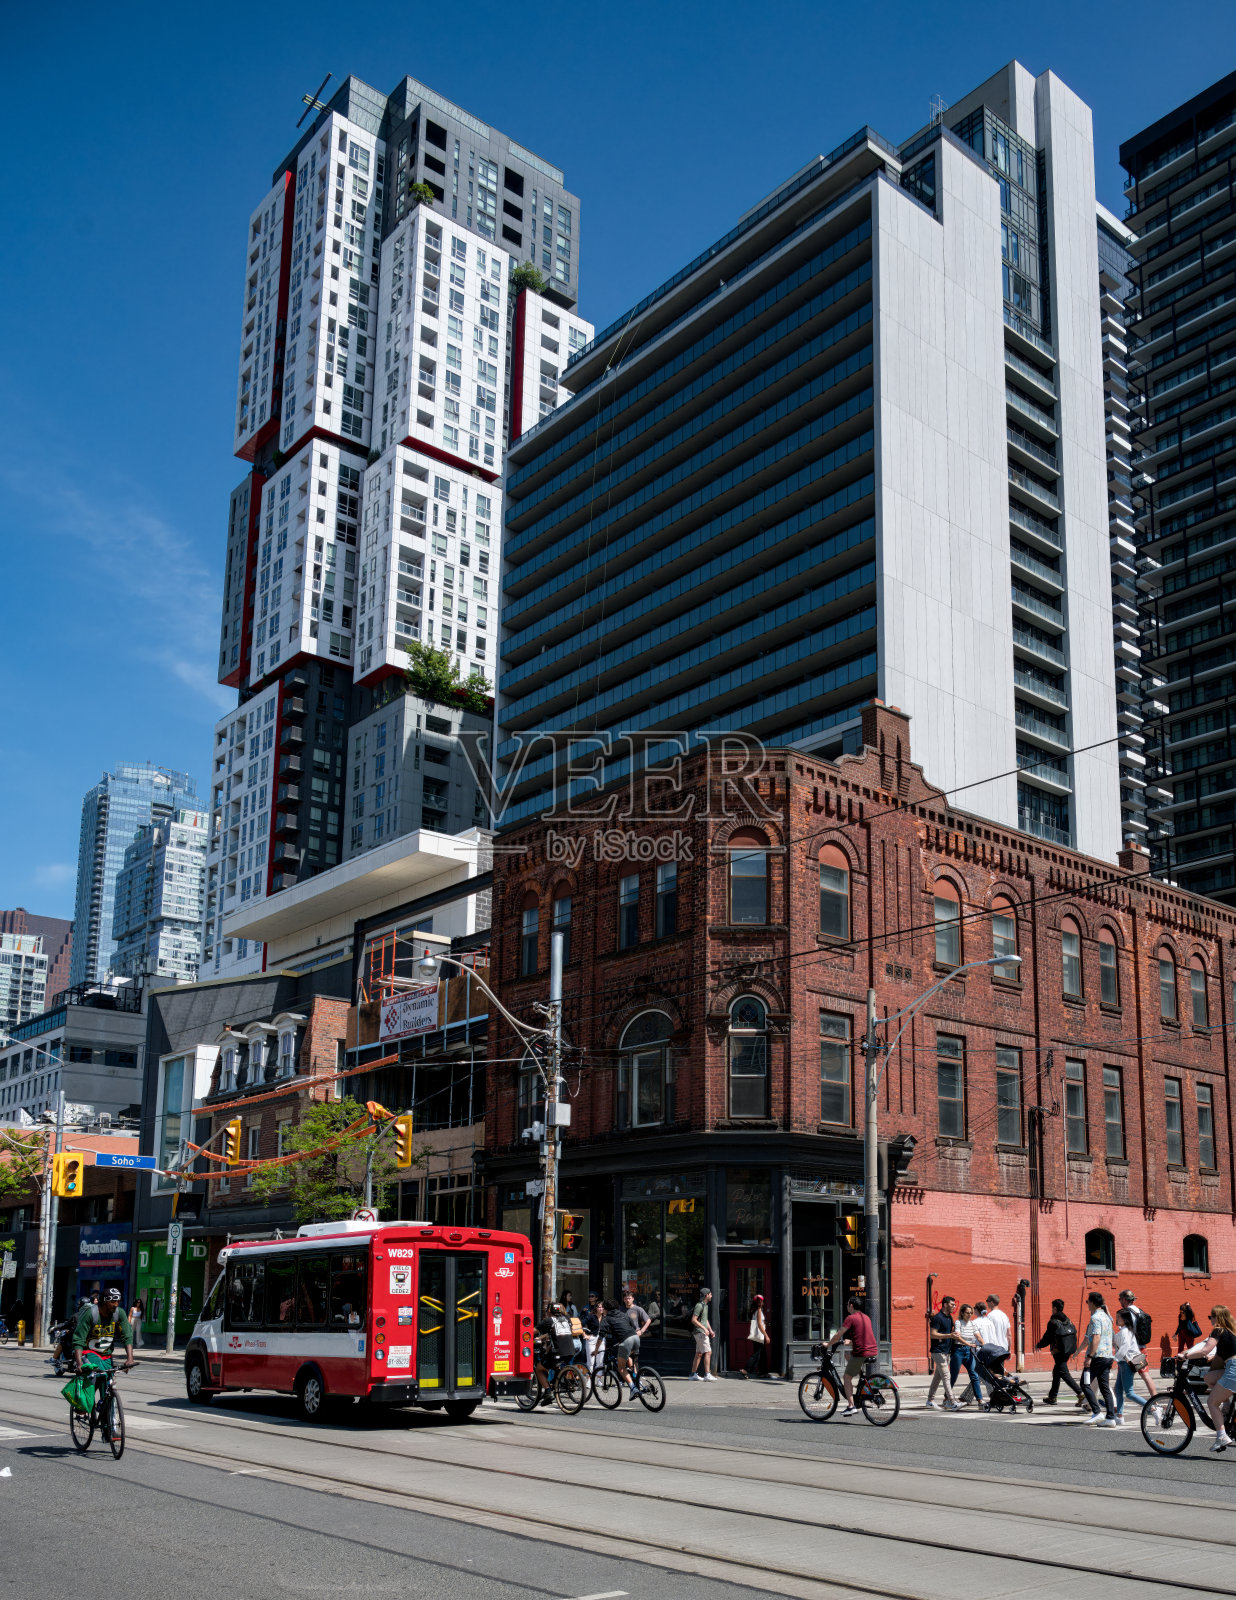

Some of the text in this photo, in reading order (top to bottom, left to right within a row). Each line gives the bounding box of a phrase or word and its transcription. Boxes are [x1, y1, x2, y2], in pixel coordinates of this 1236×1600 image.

[112, 1156, 134, 1165] Soho
[190, 1244, 207, 1257] TD
[388, 1248, 413, 1258] W829
[801, 1285, 830, 1296] PATIO
